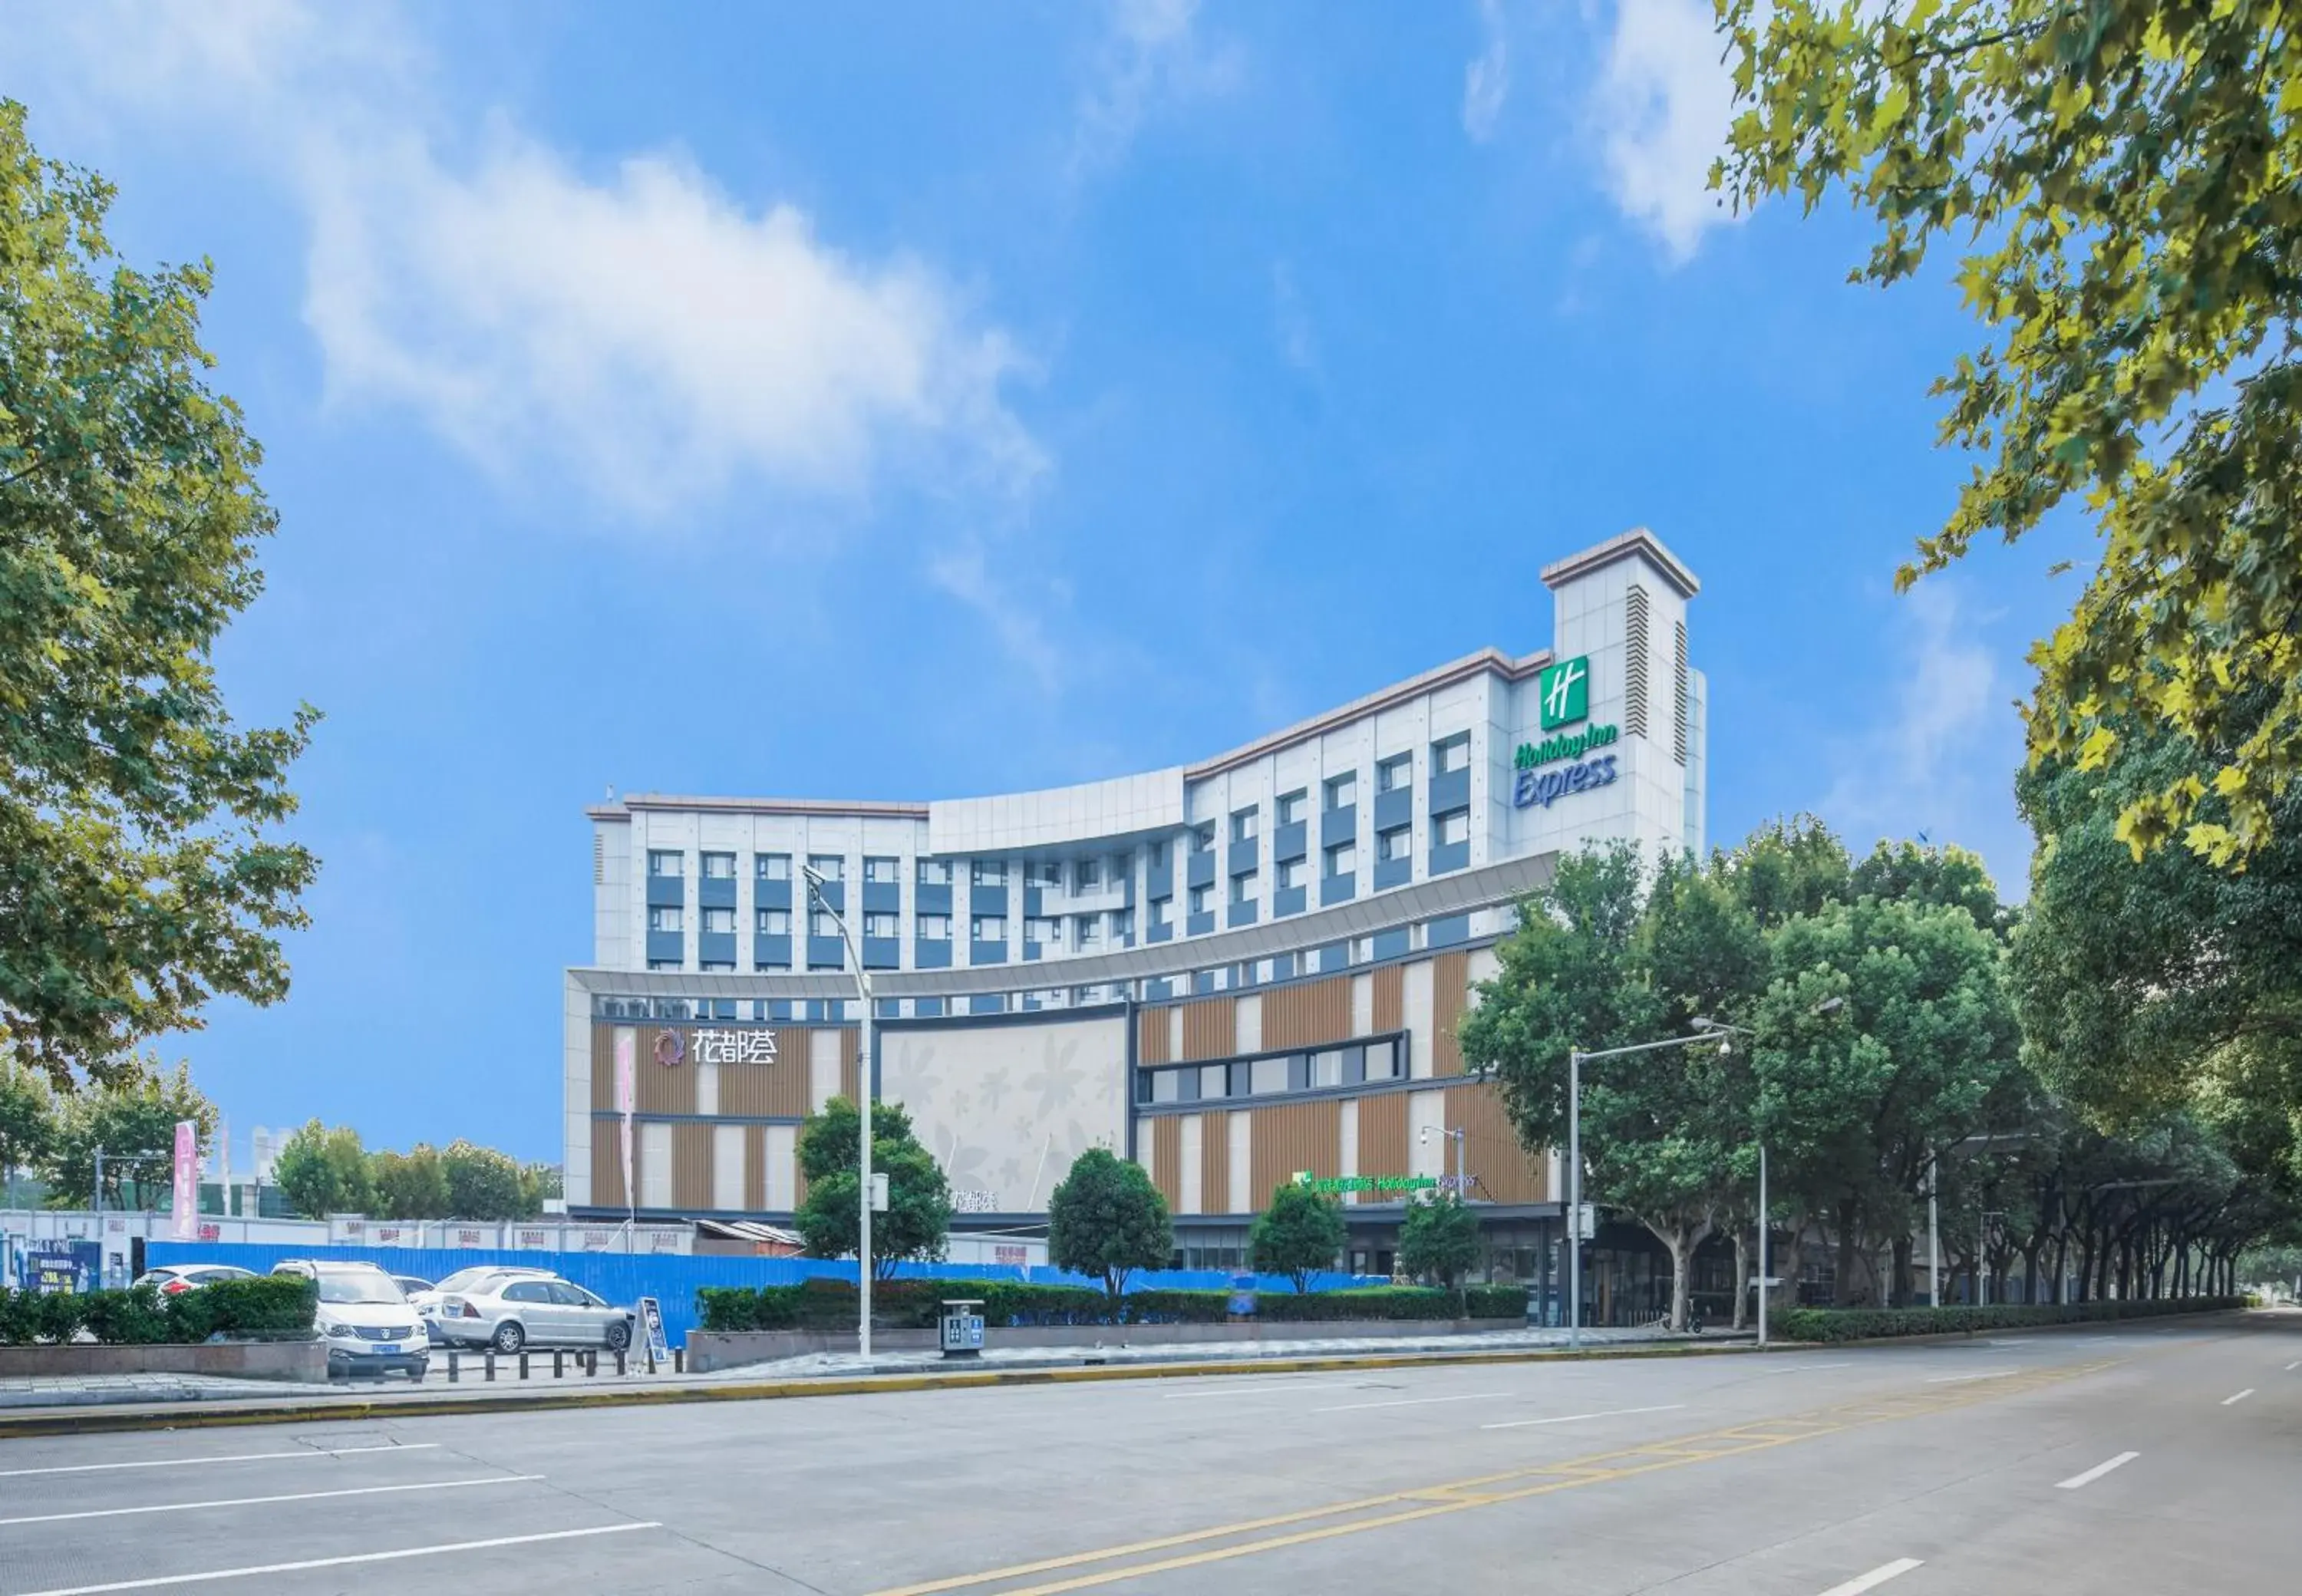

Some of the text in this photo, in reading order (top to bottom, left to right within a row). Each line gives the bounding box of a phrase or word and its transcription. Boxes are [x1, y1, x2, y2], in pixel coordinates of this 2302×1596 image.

[1513, 755, 1617, 809] Express
[690, 1028, 777, 1063] 花都荟
